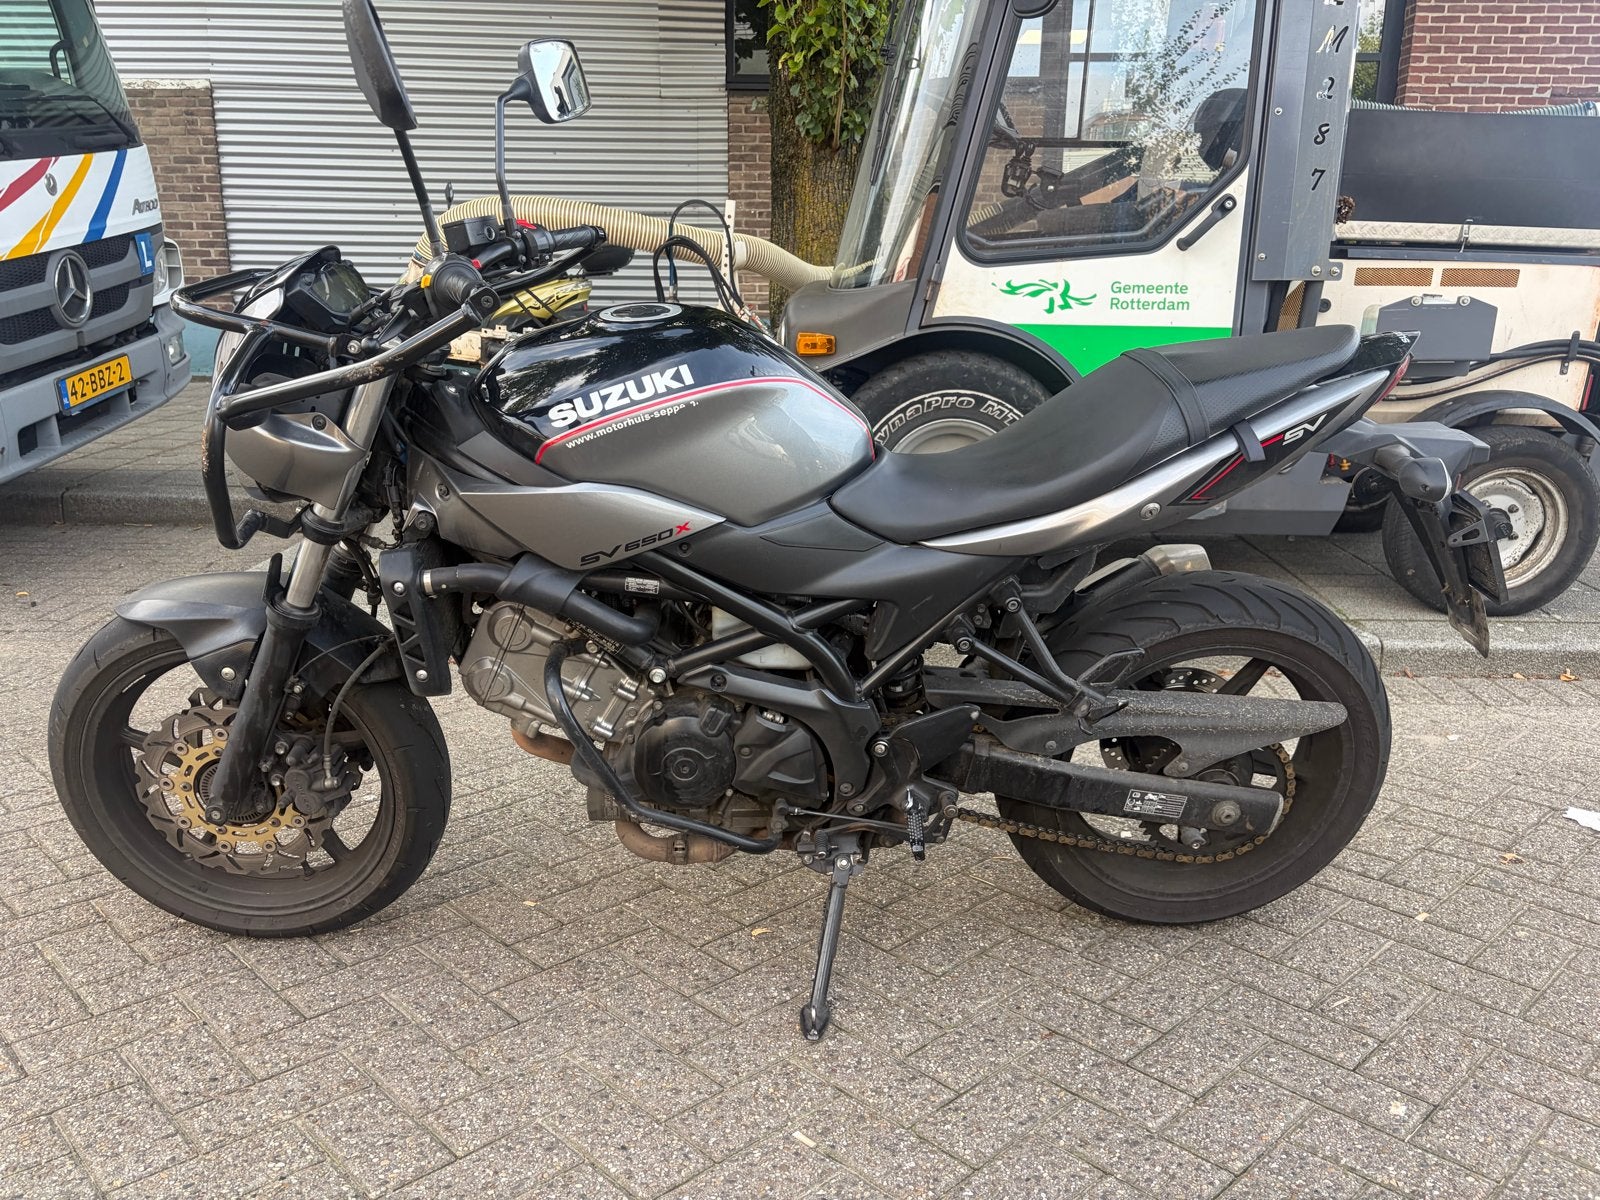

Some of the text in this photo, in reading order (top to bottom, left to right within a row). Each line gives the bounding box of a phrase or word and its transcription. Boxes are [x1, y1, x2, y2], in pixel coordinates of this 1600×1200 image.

[1310, 0, 1349, 191] M287
[140, 241, 153, 268] L
[1110, 281, 1189, 294] Gemeente
[1110, 297, 1190, 311] Rotterdam
[70, 362, 125, 400] 42-BBZ-2
[548, 364, 695, 428] SUZUKI
[875, 396, 975, 446] ynaPro
[1282, 413, 1328, 446] SV
